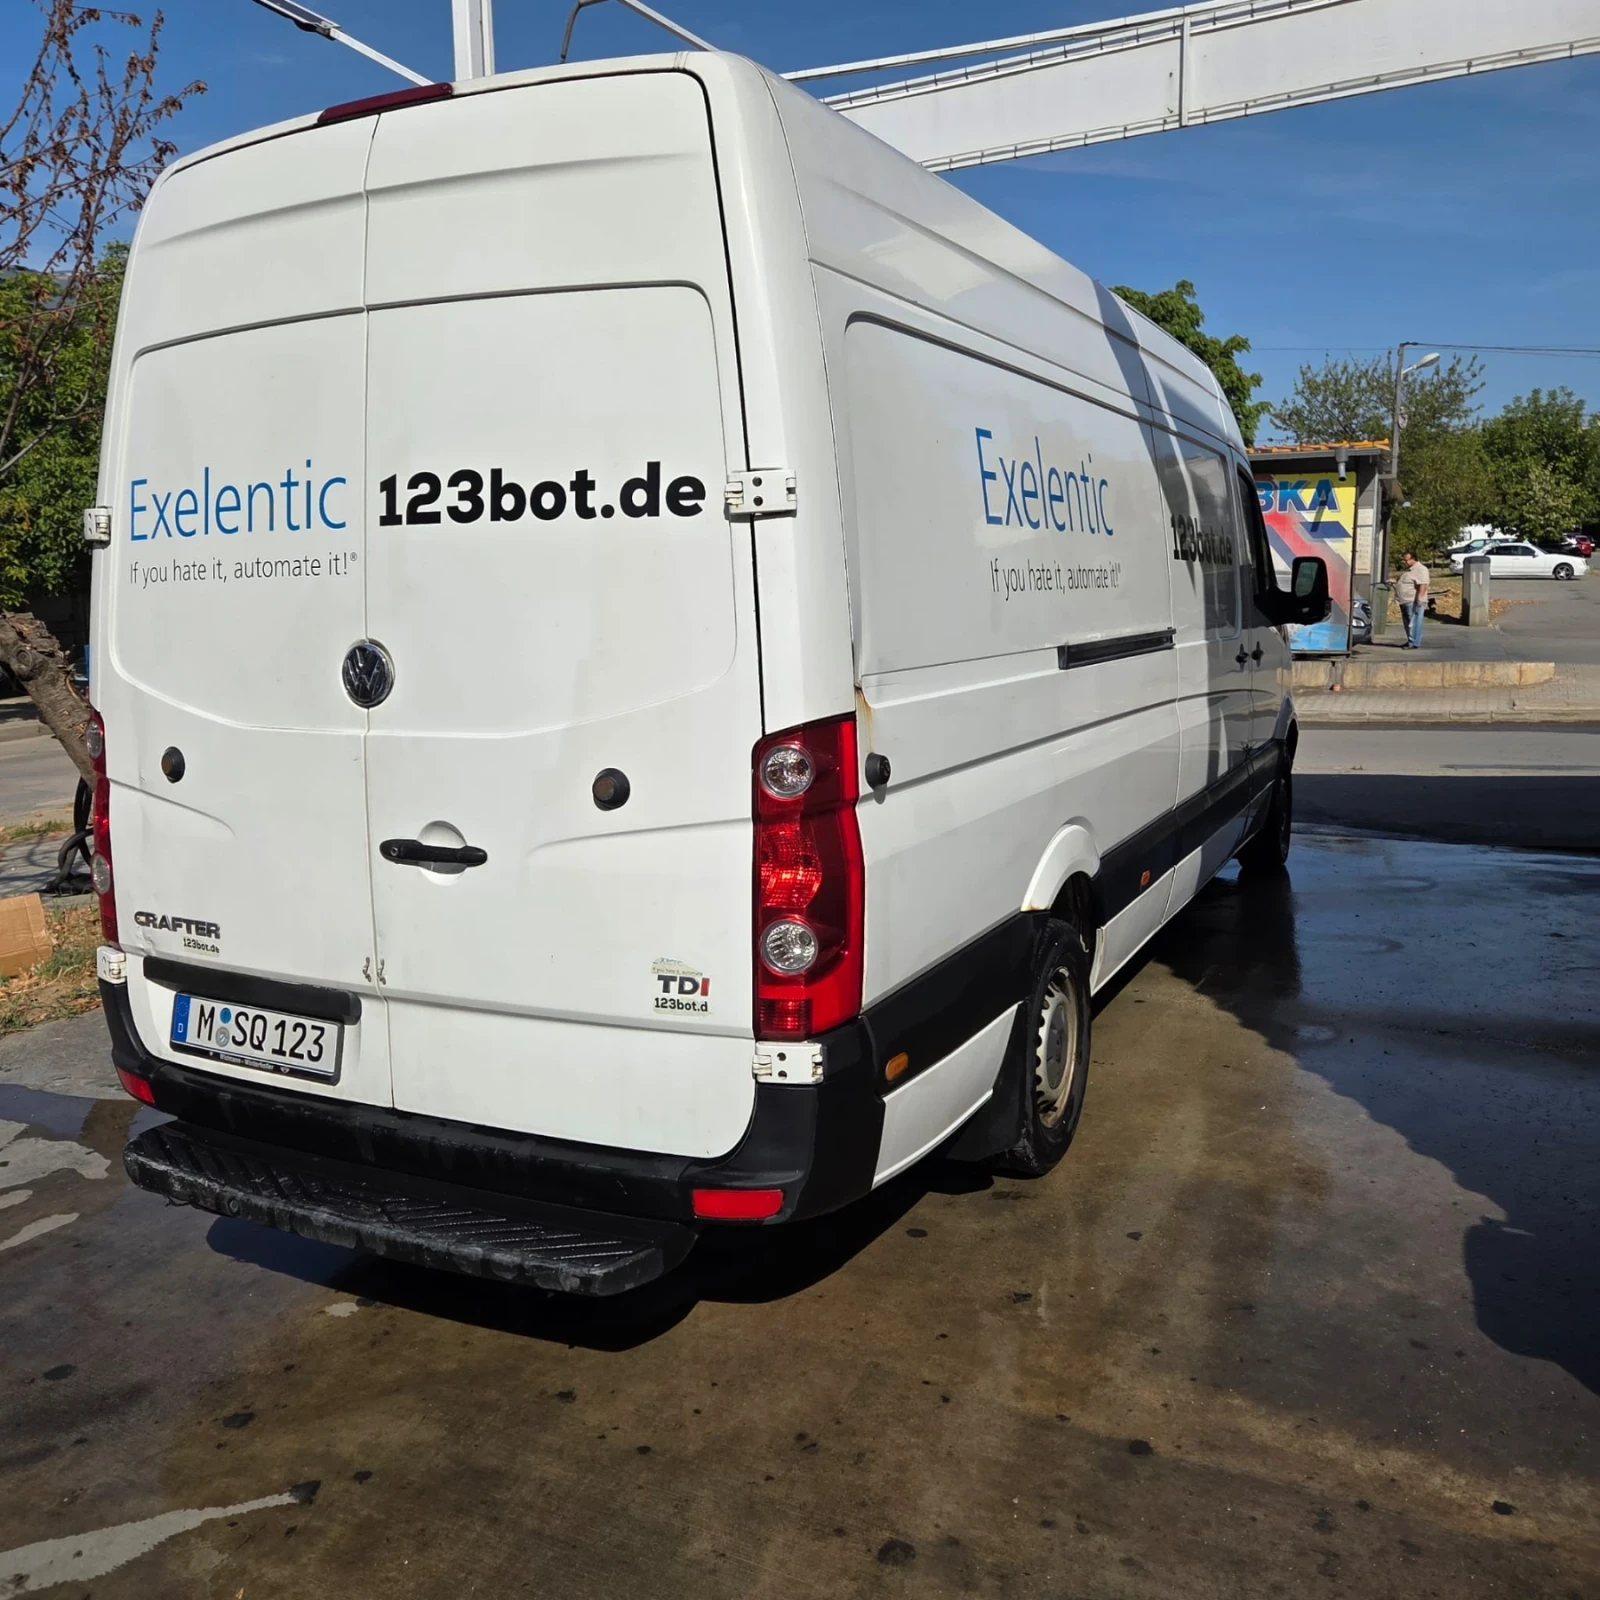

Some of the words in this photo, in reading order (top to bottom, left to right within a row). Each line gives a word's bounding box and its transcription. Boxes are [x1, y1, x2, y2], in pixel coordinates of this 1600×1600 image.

[130, 458, 348, 541] Exelentic
[379, 461, 707, 526] 123bot.de
[975, 426, 1114, 537] Exelentic
[1170, 513, 1233, 566] 123bot.de
[130, 561, 139, 584] If
[142, 565, 168, 590] you
[173, 559, 207, 582] hate
[212, 556, 227, 583] it,
[234, 556, 321, 579] automate
[990, 557, 1000, 593] If
[1002, 568, 1025, 602] you
[1027, 558, 1053, 592] hate
[1054, 559, 1066, 595] it,
[1067, 563, 1109, 590] automate
[134, 910, 221, 940] CRAFTER
[654, 997, 708, 1012] 123bot.d
[657, 974, 710, 997] TDI
[177, 1022, 184, 1034] D
[197, 1004, 216, 1042] M
[231, 1011, 268, 1052] SQ
[271, 1019, 326, 1062] 123
